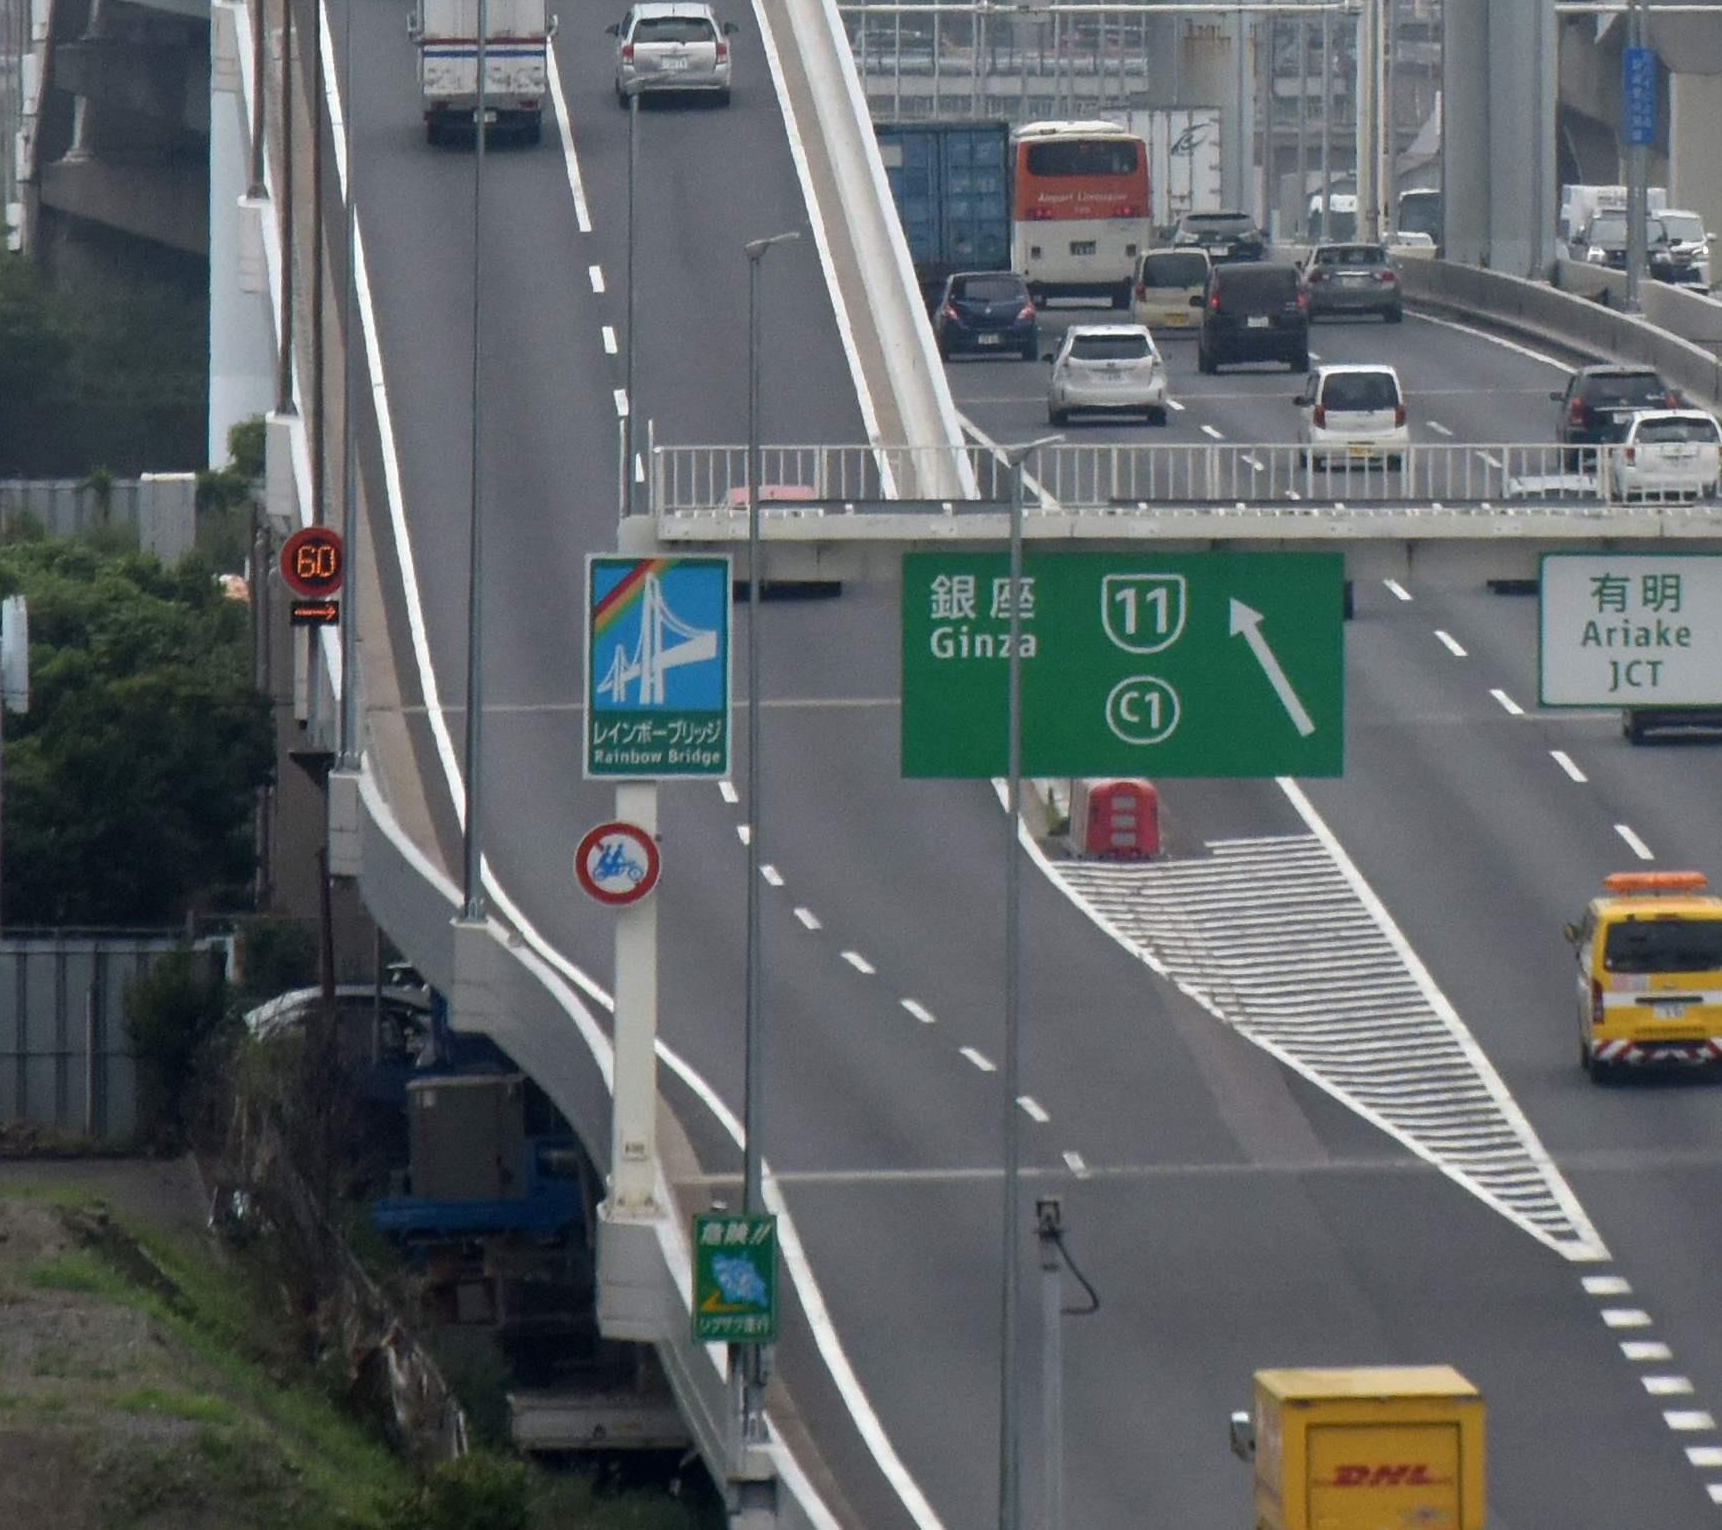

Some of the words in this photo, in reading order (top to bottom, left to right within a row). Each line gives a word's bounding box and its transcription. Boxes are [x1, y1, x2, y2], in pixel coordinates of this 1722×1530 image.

[297, 545, 335, 578] 60
[930, 574, 1036, 620] 銀座
[1589, 572, 1681, 613] 有明
[1114, 587, 1168, 635] 11
[930, 625, 1037, 659] Ginza
[1580, 619, 1691, 648] Ariake
[1608, 659, 1664, 693] JCT
[1119, 690, 1161, 729] C1
[593, 720, 722, 745] レインボーブリッジ
[595, 748, 663, 764] Rainbow
[668, 748, 721, 767] Bridge
[1335, 1464, 1430, 1488] DHL
